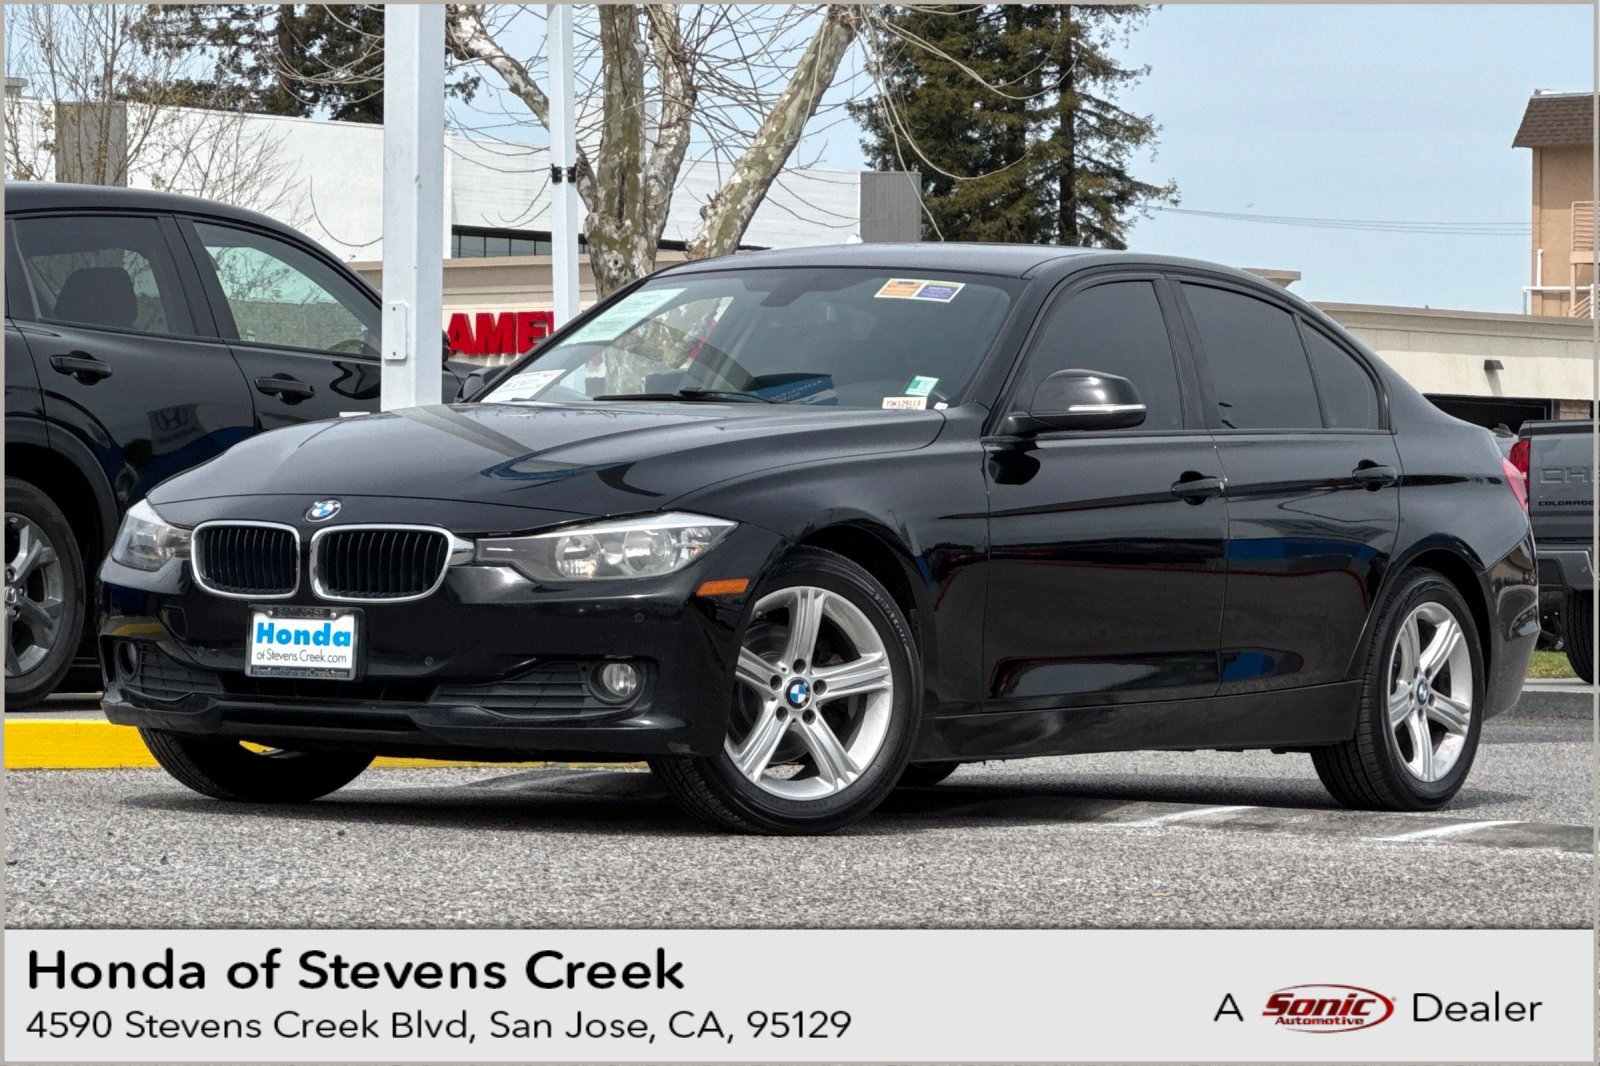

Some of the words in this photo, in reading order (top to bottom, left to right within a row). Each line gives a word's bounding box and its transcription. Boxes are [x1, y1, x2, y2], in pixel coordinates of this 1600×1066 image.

[1540, 467, 1594, 483] CH
[256, 622, 351, 647] Honda
[256, 650, 265, 661] of
[266, 648, 298, 662] Stevens
[299, 648, 347, 663] Creek.com
